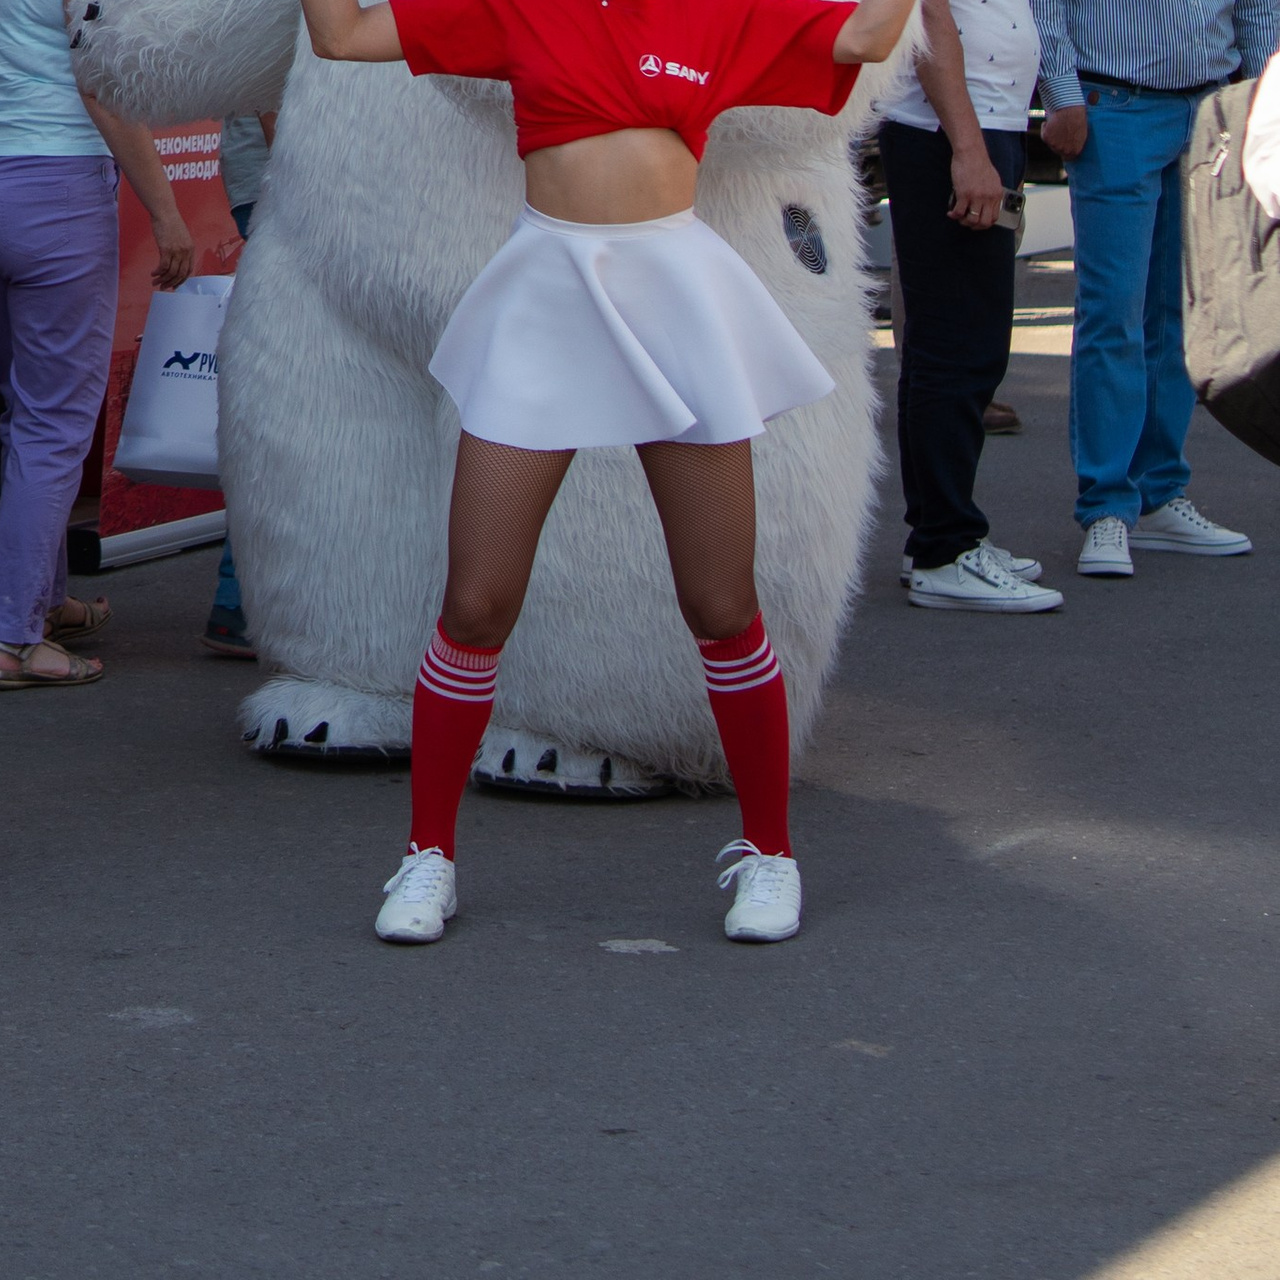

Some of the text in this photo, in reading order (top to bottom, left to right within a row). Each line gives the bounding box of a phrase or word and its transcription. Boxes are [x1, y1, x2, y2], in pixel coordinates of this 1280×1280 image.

[665, 61, 710, 85] SANY
[154, 132, 221, 155] РЕКОМЕНДО
[163, 159, 220, 181] ОИЗВОДИ
